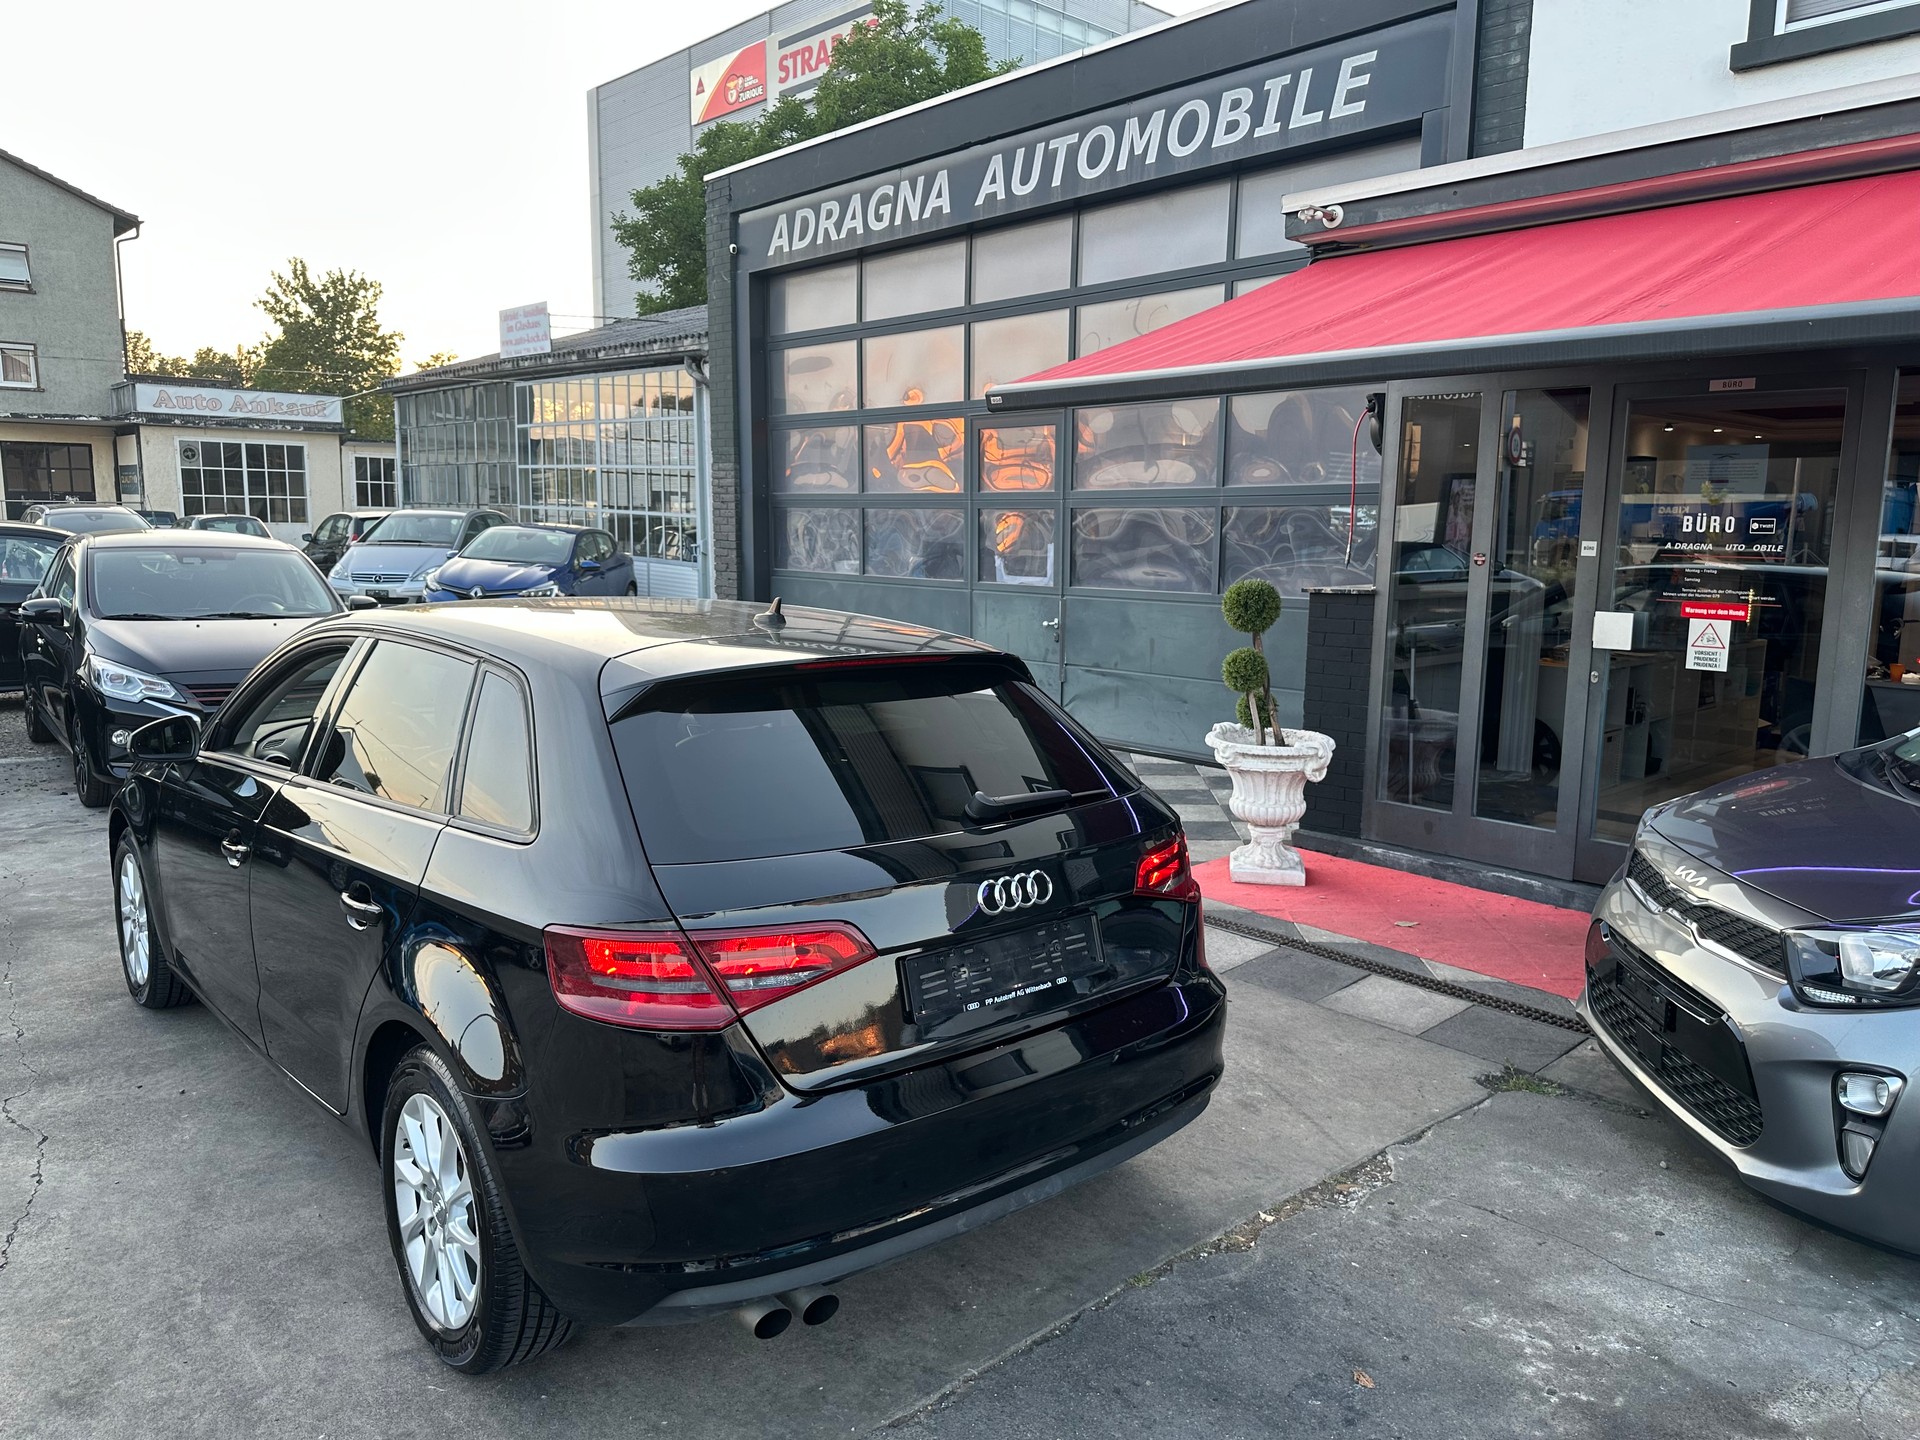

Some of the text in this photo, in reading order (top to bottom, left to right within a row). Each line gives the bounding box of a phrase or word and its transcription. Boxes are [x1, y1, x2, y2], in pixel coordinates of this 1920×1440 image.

[738, 85, 764, 103] ZURIQUE
[767, 51, 1379, 257] ADRAGNA AUTOMOBILE
[1722, 380, 1743, 389] BÜRO
[153, 390, 327, 417] Auto Ankauf
[1682, 513, 1735, 533] BÜRO
[1725, 543, 1745, 552] UTO
[1752, 545, 1784, 553] OBILE
[1685, 607, 1708, 615] Warnung
[985, 981, 1052, 1006] PP Autotreff AG Wittenbach
